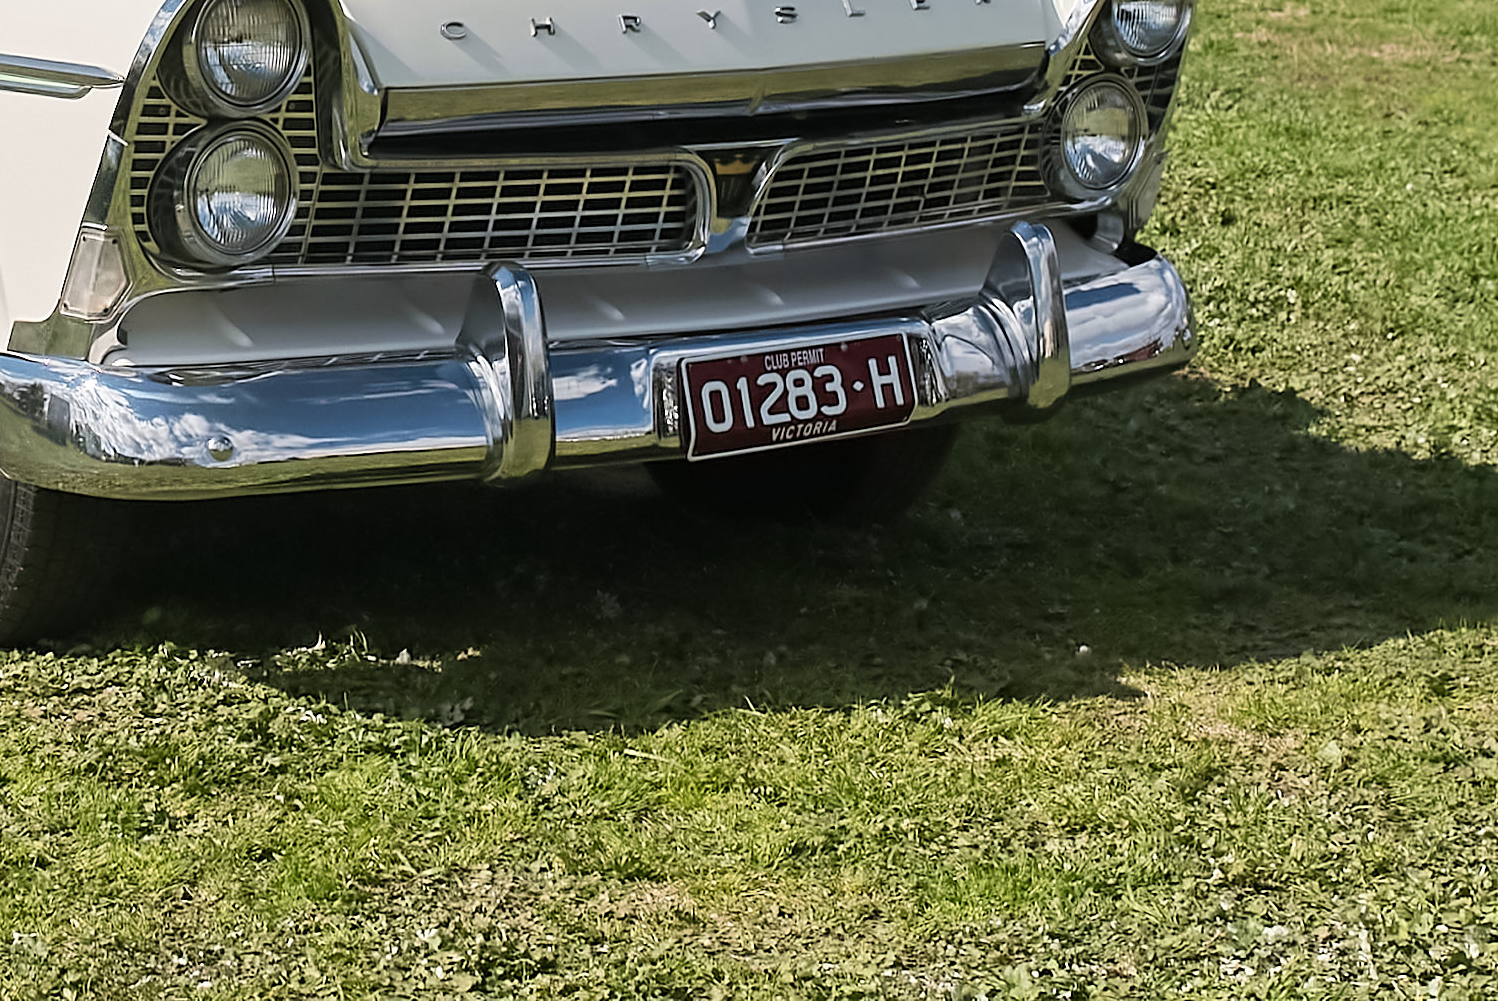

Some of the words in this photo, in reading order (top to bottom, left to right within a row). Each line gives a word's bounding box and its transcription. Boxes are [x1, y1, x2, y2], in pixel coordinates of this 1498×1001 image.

[764, 354, 790, 371] CLUB
[790, 348, 824, 367] PERMIT
[771, 419, 837, 442] VICTORIA
